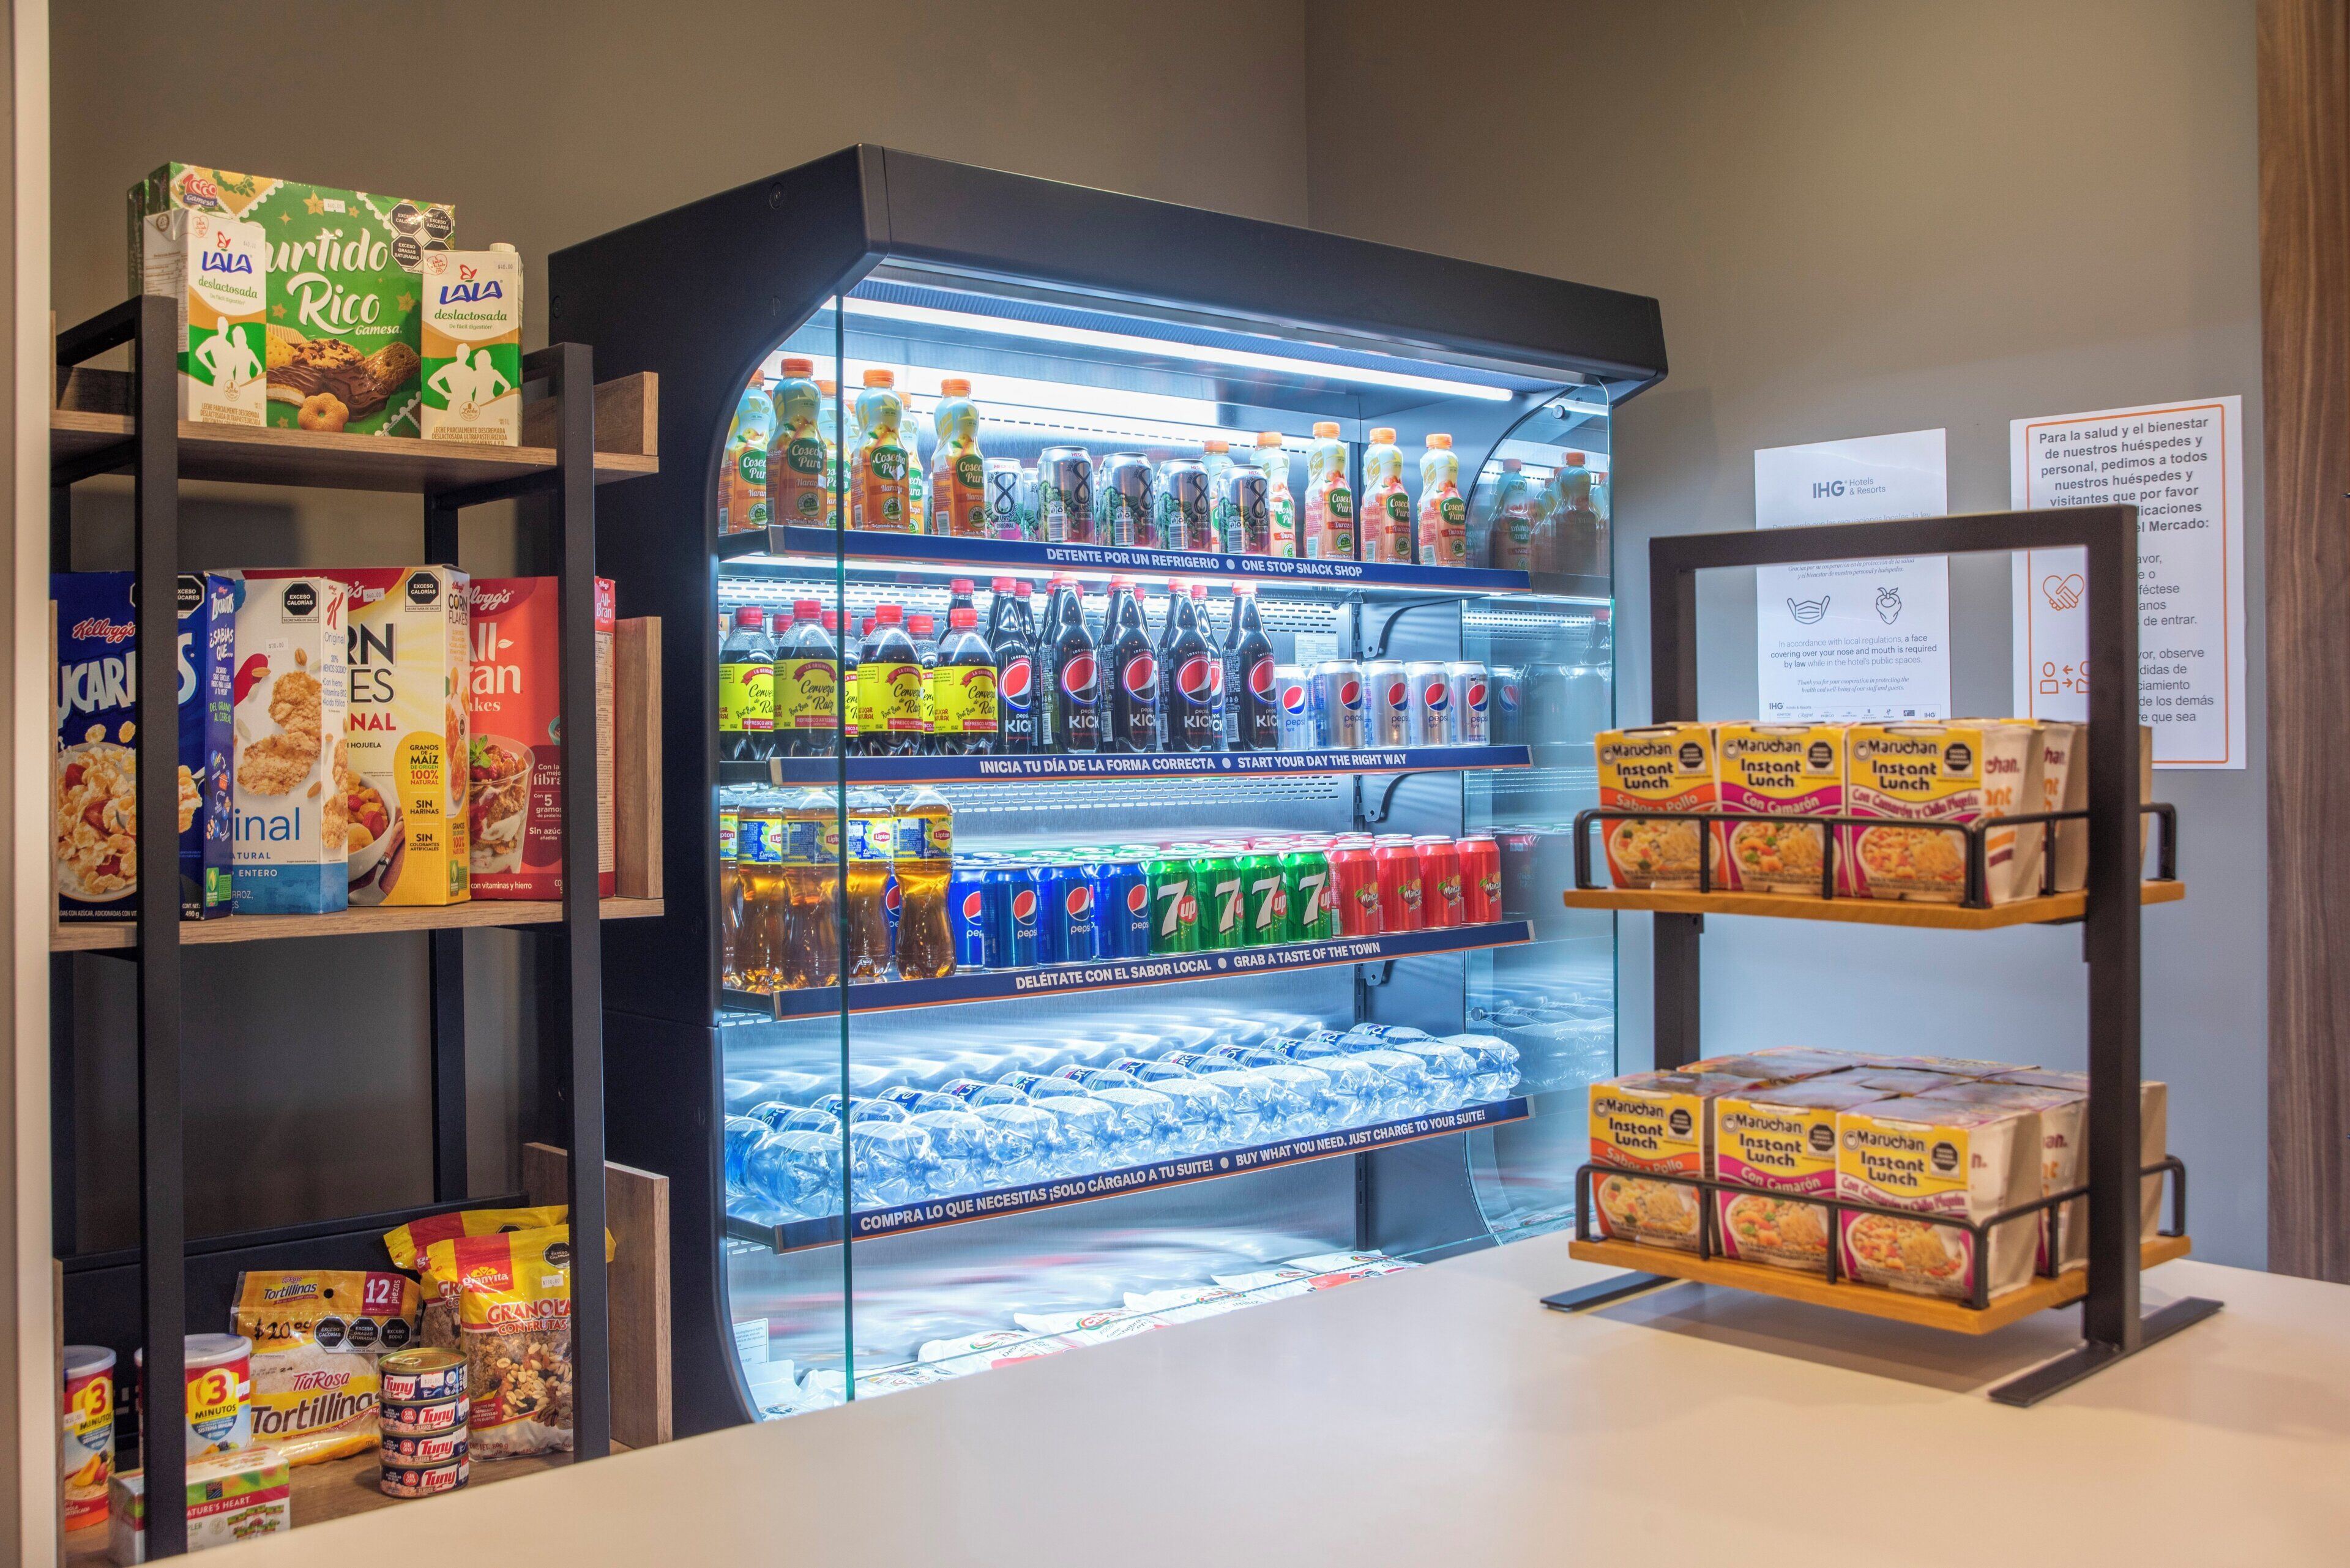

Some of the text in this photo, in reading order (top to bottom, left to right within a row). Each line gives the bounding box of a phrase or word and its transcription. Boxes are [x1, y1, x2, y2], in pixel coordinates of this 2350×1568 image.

[266, 228, 387, 272] urtido
[202, 251, 252, 274] LALA
[199, 275, 257, 298] deslactosada
[439, 281, 502, 305] LALA
[286, 272, 380, 334] Rico
[435, 308, 507, 321] deslactosada
[355, 325, 400, 335] Gamesa
[2040, 419, 2208, 444] Para la salud y el bienestar
[791, 444, 823, 459] Cosecha
[2045, 436, 2202, 459] de nuestros huéspedes y
[798, 457, 821, 469] Pura
[2042, 461, 2097, 478] personal,
[2102, 458, 2155, 472] pedimos
[2170, 452, 2207, 463] todos
[1813, 480, 1845, 498] IHG
[1849, 477, 1873, 487] Hotels
[2055, 471, 2193, 490] nuestros huéspedes y
[1857, 486, 1886, 495] Resorts
[2050, 487, 2198, 506] visitantes que por favor
[2149, 518, 2209, 532] Mercado:
[1047, 548, 1219, 569] DETENTE POR UN REFRIGERIO
[1242, 560, 1362, 577] ONE STOP SNACK SHOP
[448, 594, 468, 611] CORN
[449, 610, 468, 625] FLAKES
[72, 618, 136, 643] Kellogg's
[1828, 638, 1842, 646] with
[1862, 636, 1903, 645] regulations,
[1871, 646, 1895, 654] mouth
[1906, 644, 1936, 654] required
[1784, 660, 1792, 669] by
[1871, 657, 1893, 666] public
[800, 679, 835, 696] Cerveza
[1069, 715, 1099, 728] KICK
[1612, 741, 1672, 756] Maruchan
[1737, 739, 1802, 753] Maruchan
[410, 753, 438, 764] MAÍZ
[980, 758, 1215, 773] INICIA TU DÍA DE LA FORMA CORRECTA
[1238, 754, 1406, 768] START YOUR DAY THE RIGHT WAY
[1740, 759, 1800, 772] Instant
[411, 770, 438, 780] 100%
[1617, 763, 1674, 776] Instant
[1624, 777, 1669, 790] Lunch
[1748, 774, 1794, 787] Lunch
[1157, 879, 1196, 936] 7 up
[1017, 928, 1037, 939] pepsi
[1234, 943, 1380, 967] GRAB A TASTE OF THE TOWN
[1016, 960, 1211, 989] DELÉITATE CON EL SABOR LOCAL
[1737, 1115, 1802, 1133] Maruchan
[1236, 1110, 1485, 1166] BUY WHAT YOU NEED. JUST CHARGE TO YOUR SUITE!
[1739, 1135, 1802, 1153] Instant
[1746, 1149, 1794, 1167] Lunch
[861, 1159, 1213, 1230] COMPRA LO QUE NECESITAS ¡SOLO CÁRGALO A TU SUITE!
[264, 1283, 317, 1300] Tortillinas
[366, 1279, 400, 1304] 12 piezas
[487, 1299, 570, 1324] GRANOLA
[498, 1318, 567, 1335] CON FRUTAS
[206, 1375, 227, 1405] 3
[386, 1376, 414, 1395] Tuny
[195, 1404, 236, 1419] MINUTOS
[422, 1408, 454, 1424] Tuny
